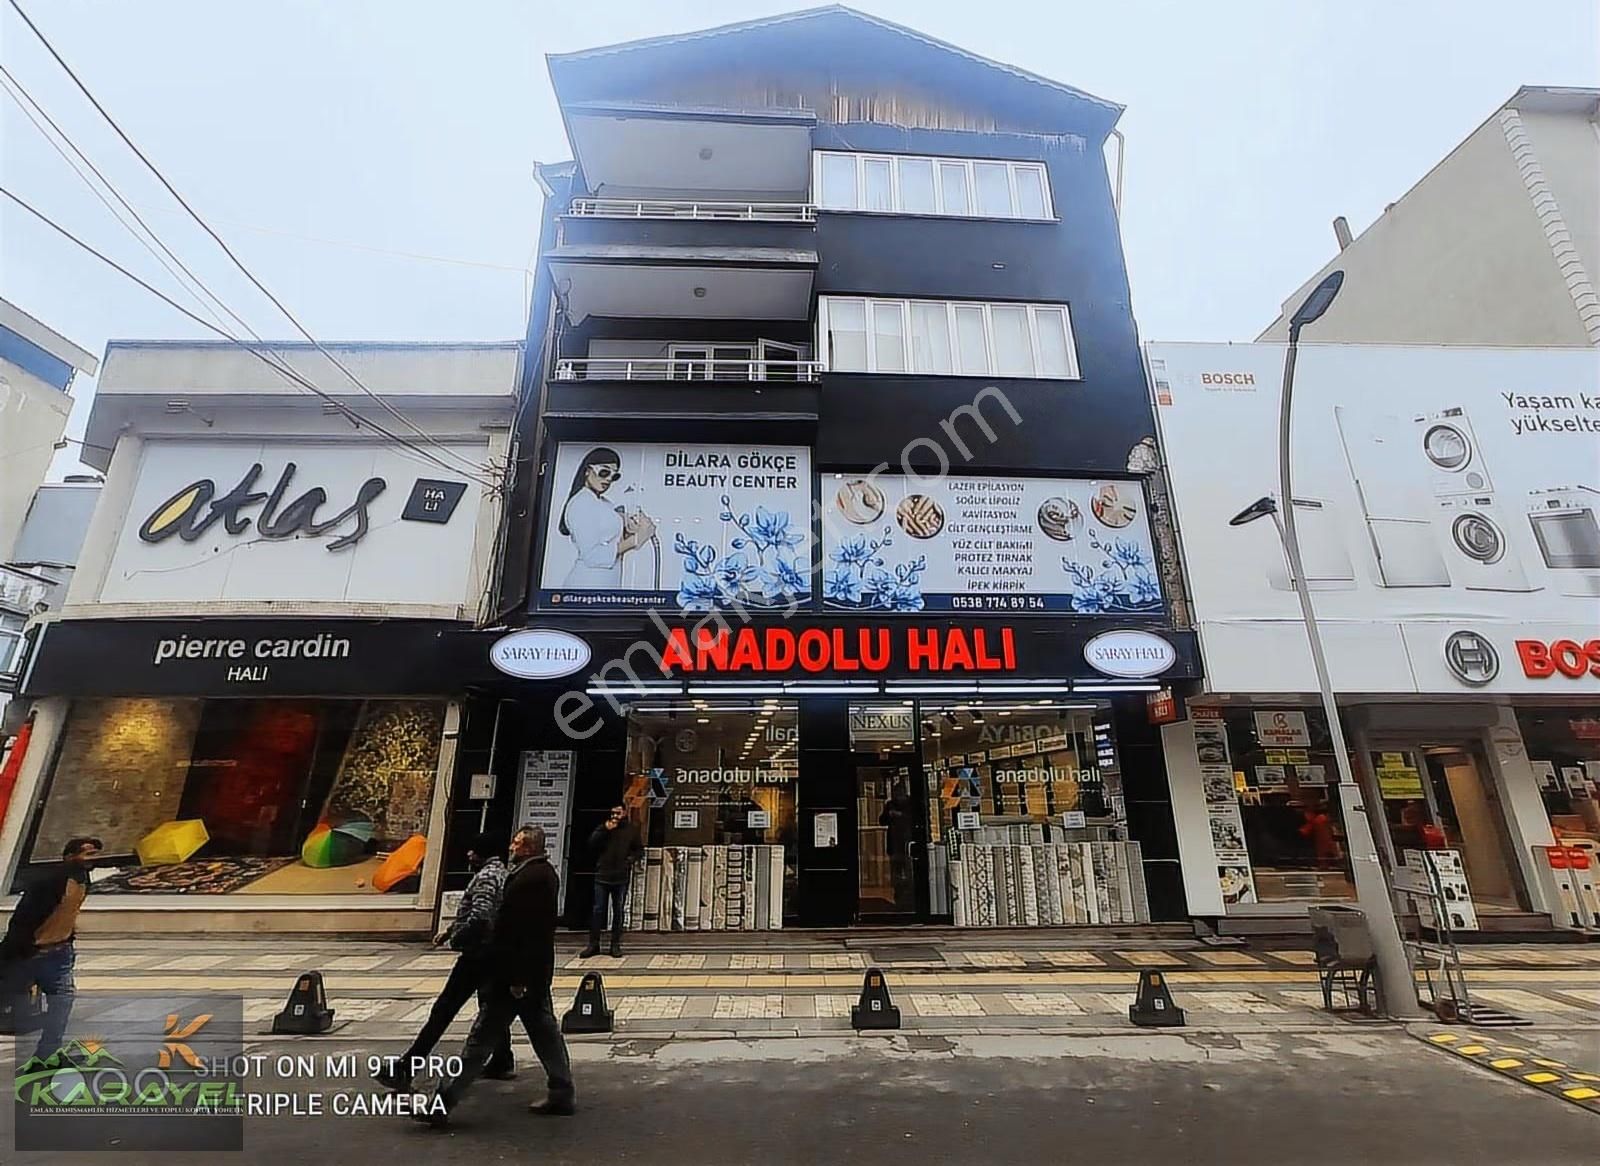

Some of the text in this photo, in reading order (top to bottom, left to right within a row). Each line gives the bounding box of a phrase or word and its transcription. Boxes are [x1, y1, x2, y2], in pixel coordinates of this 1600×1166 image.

[1202, 373, 1255, 384] BOSCH
[1501, 392, 1574, 413] Yaşam
[665, 450, 797, 472] DİLARA GÖKÇE
[664, 474, 797, 489] BEAUTY CENTER
[948, 481, 1024, 492] LAZER EPİLASYON
[423, 487, 445, 500] HA
[139, 463, 386, 551] atlas
[955, 496, 988, 505] SOĞUK
[962, 510, 1017, 520] KAVİTASYON
[967, 524, 1033, 535] GENÇLEŞTİRME
[952, 539, 971, 549] YÜZ
[954, 553, 1033, 563] PROTEZ TIRNAK
[957, 566, 1033, 576] KALICI MAKYAJ
[967, 579, 990, 590] İPEK
[952, 596, 1045, 608] 0538 774 89 54
[154, 633, 350, 664] pierre cardin
[501, 647, 541, 661] SARAY
[660, 627, 1017, 672] ANADOLU HALI
[1095, 646, 1133, 659] SARAY
[227, 666, 268, 681] HALI
[853, 715, 911, 729] NEXUS
[675, 766, 750, 783] anadolu
[996, 767, 1101, 783] anadolu hali
